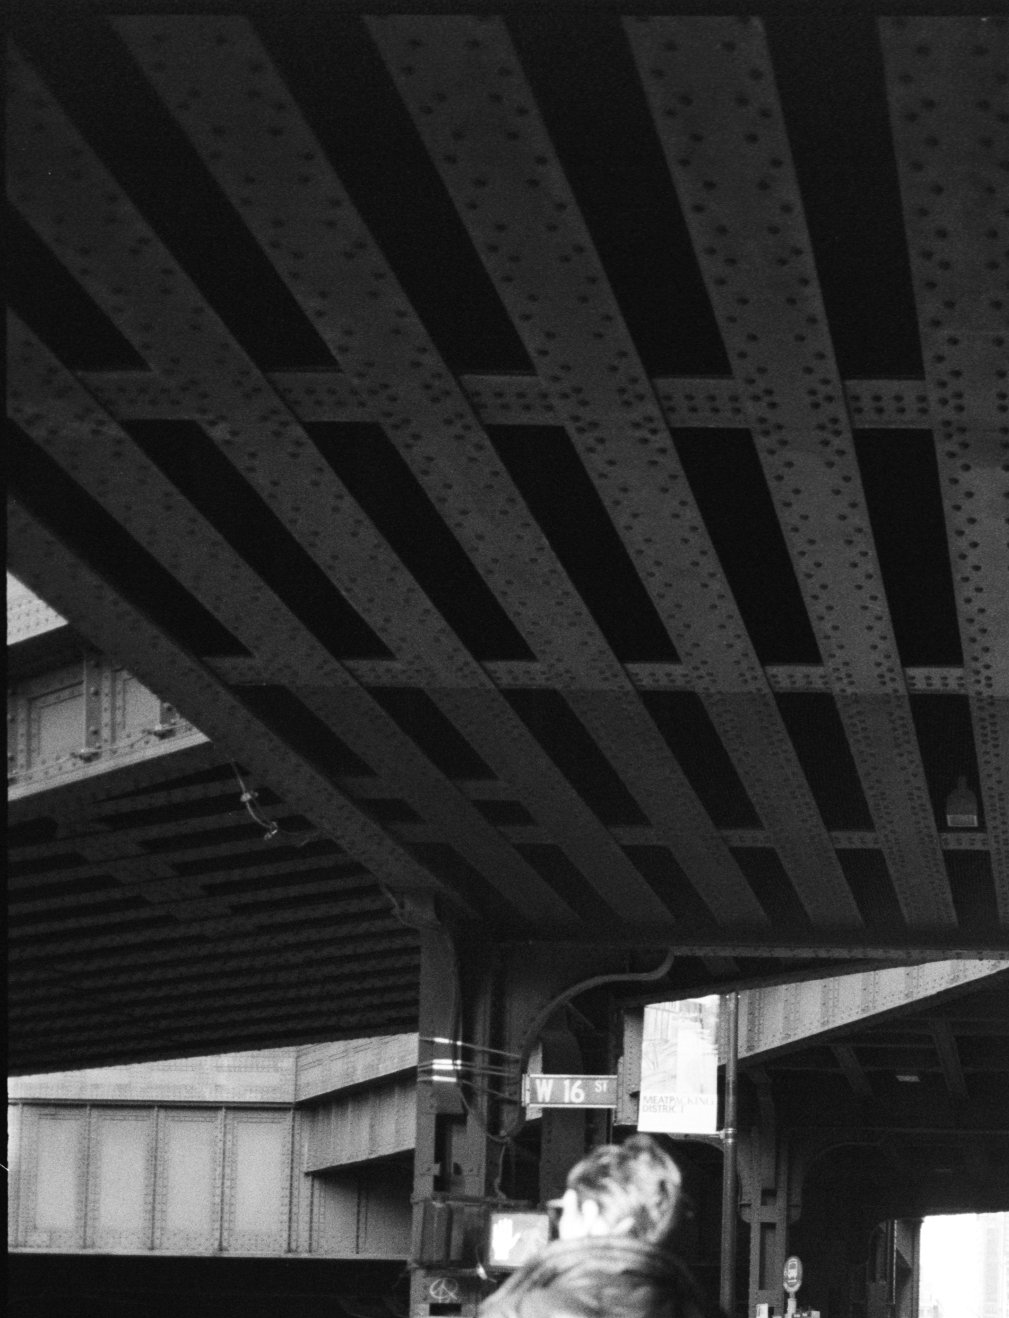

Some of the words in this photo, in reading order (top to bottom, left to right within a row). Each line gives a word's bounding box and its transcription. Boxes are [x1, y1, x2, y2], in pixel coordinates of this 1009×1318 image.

[535, 1078, 554, 1103] W
[563, 1079, 585, 1104] 16
[594, 1079, 609, 1093] ST
[642, 1095, 715, 1105] MEATPAKING
